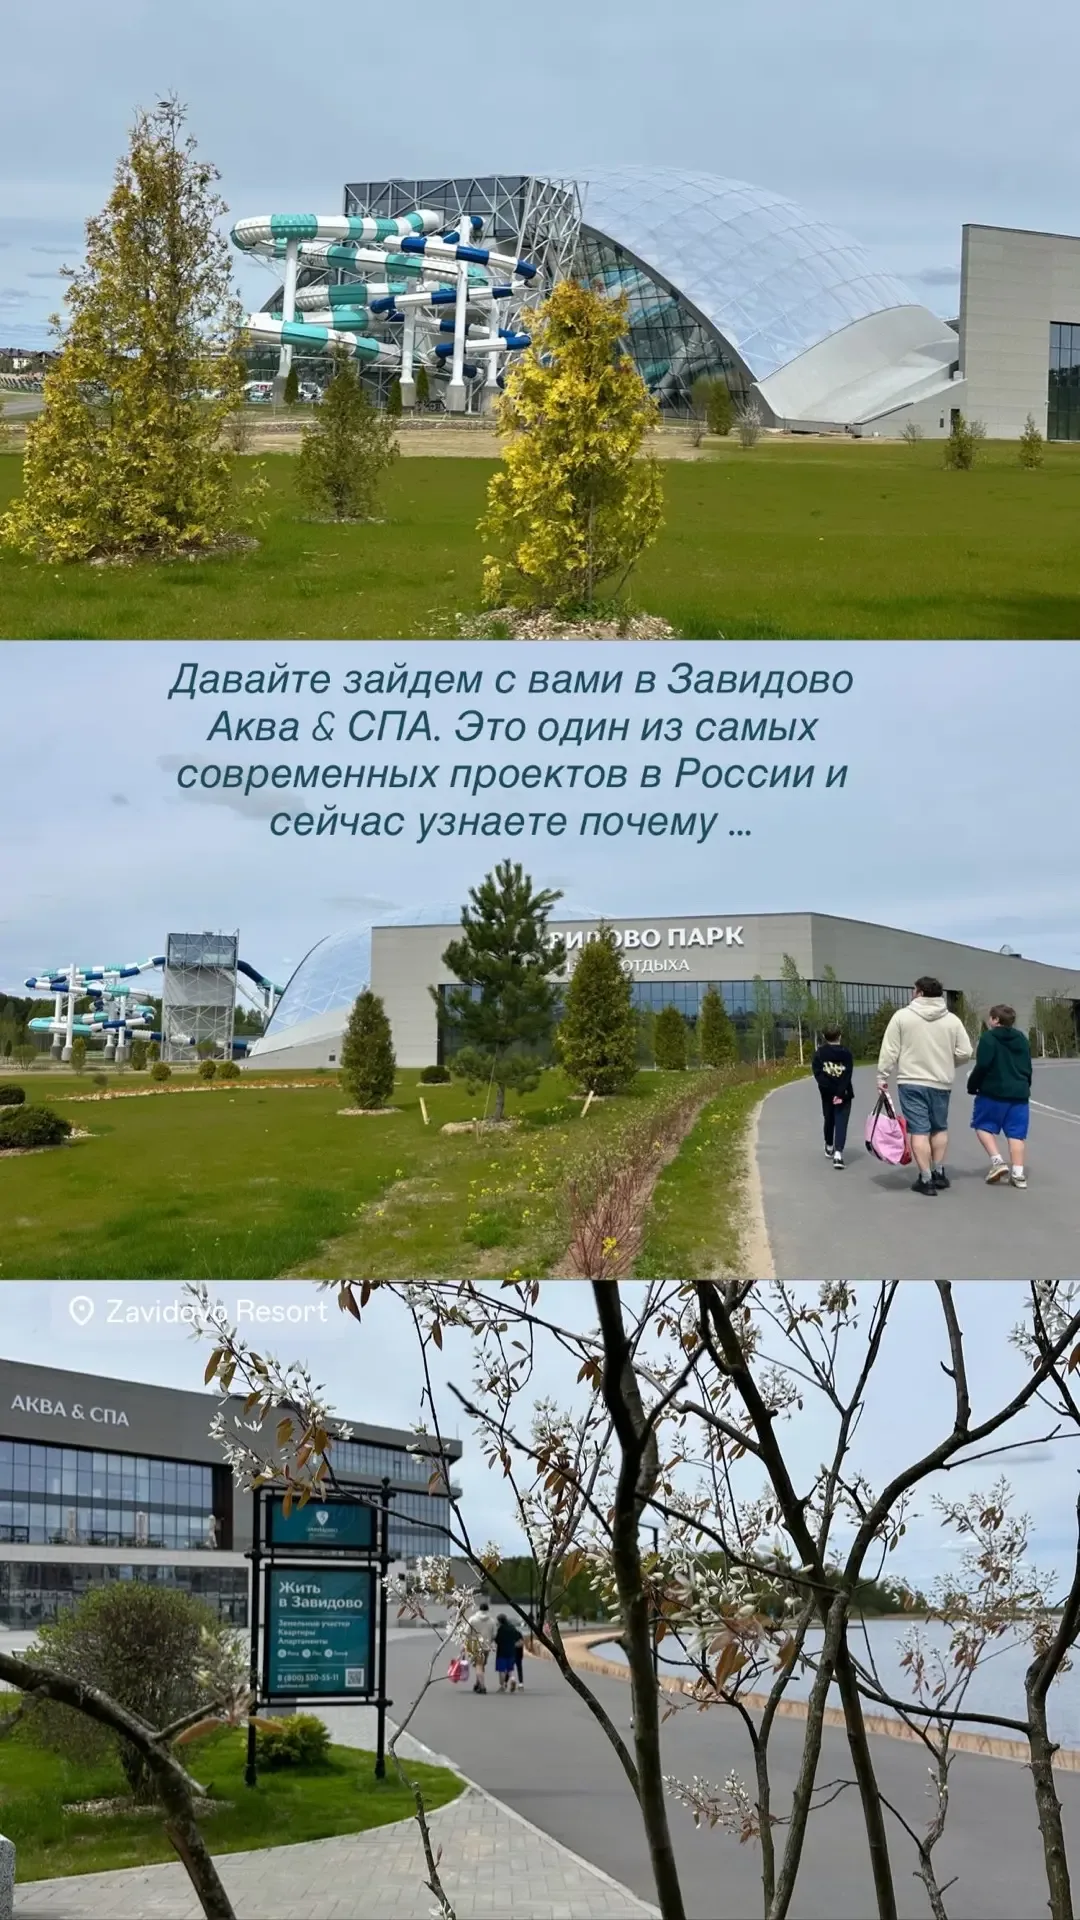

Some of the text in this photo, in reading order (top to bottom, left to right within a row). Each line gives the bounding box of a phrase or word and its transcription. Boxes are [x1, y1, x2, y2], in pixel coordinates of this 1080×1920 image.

[544, 926, 744, 950] ВИДОВО ПАРК
[621, 959, 690, 973] ОТДЫХА
[10, 1394, 130, 1427] АКВА & СПА
[279, 1581, 321, 1594] Жить
[279, 1595, 363, 1610] в Завидово
